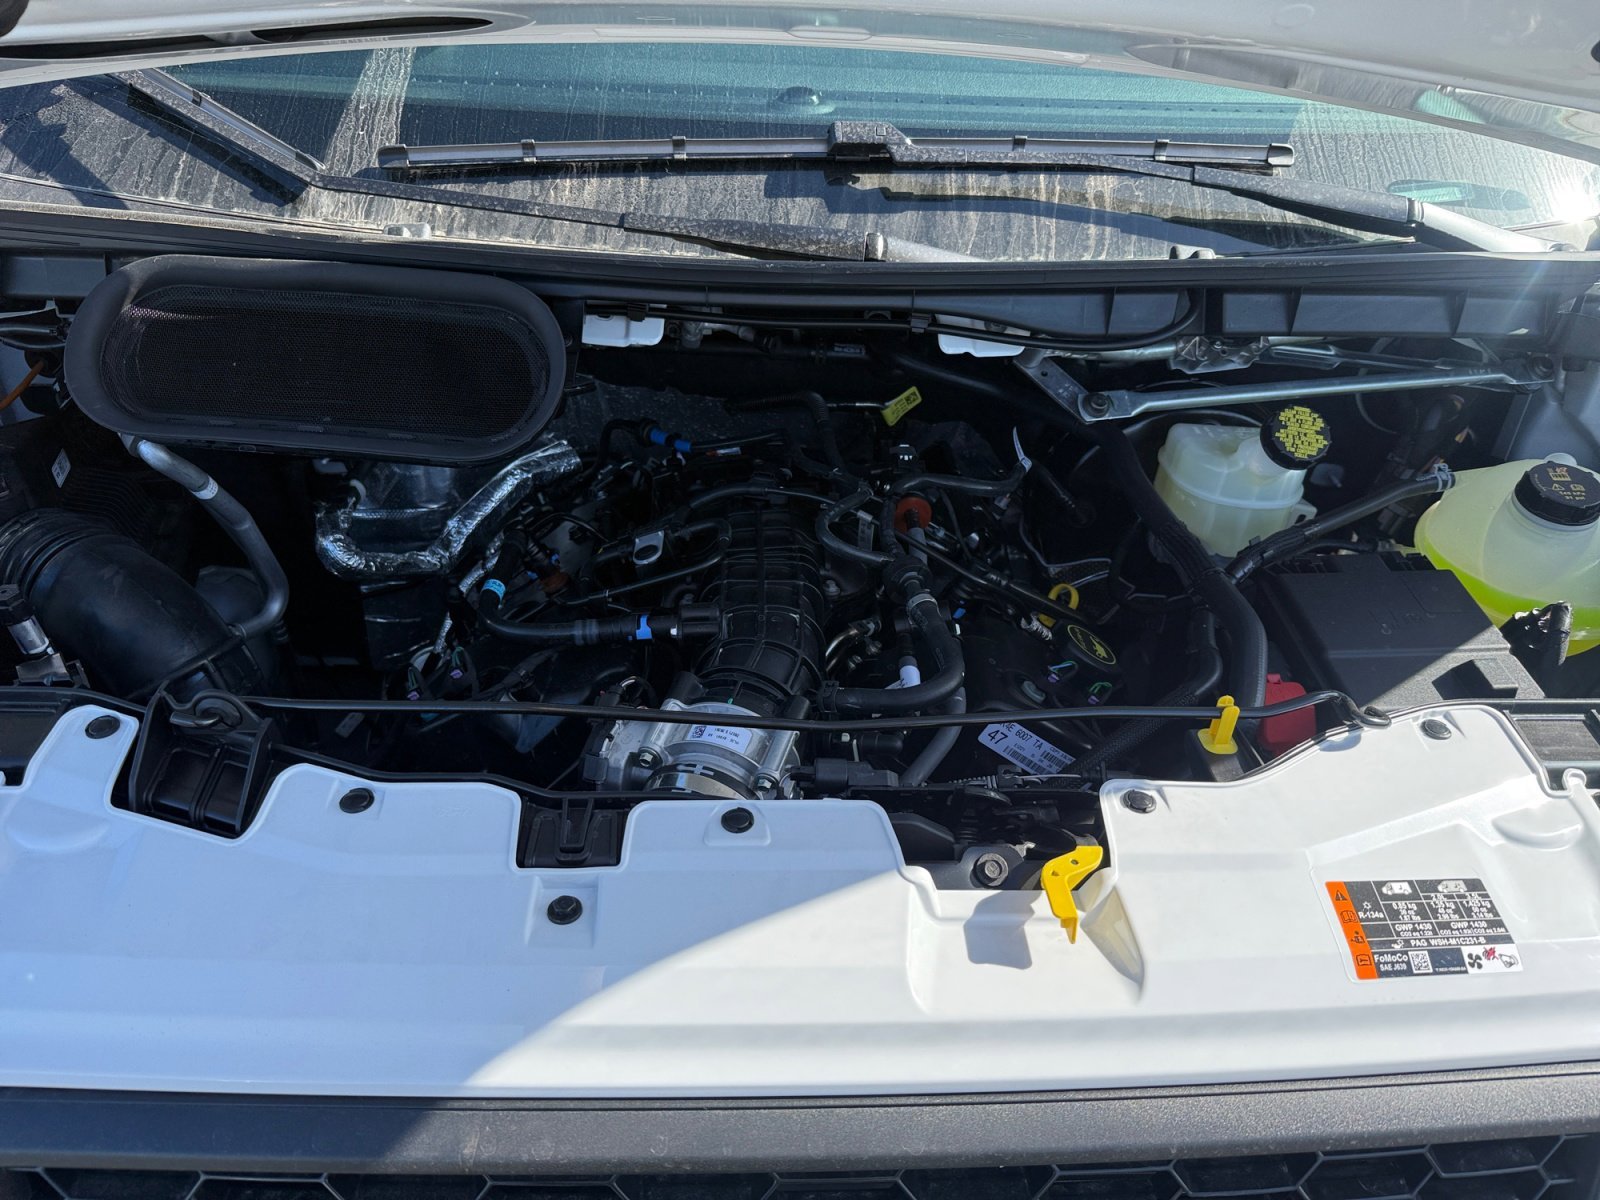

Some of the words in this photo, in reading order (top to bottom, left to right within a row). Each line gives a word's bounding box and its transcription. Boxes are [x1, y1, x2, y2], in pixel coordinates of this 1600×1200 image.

[987, 729, 1009, 745] 47
[1015, 729, 1033, 742] 6007
[1032, 739, 1044, 751] TA
[1407, 902, 1418, 911] kg
[1445, 900, 1455, 909] kg
[1480, 899, 1491, 908] kg
[1358, 910, 1385, 919] R-134a
[1395, 923, 1413, 931] GWP
[1410, 939, 1427, 947] PAG
[1429, 937, 1486, 946] WSH-M1C231-B
[1374, 953, 1408, 963] FoMoCo
[1379, 964, 1392, 972] SAE
